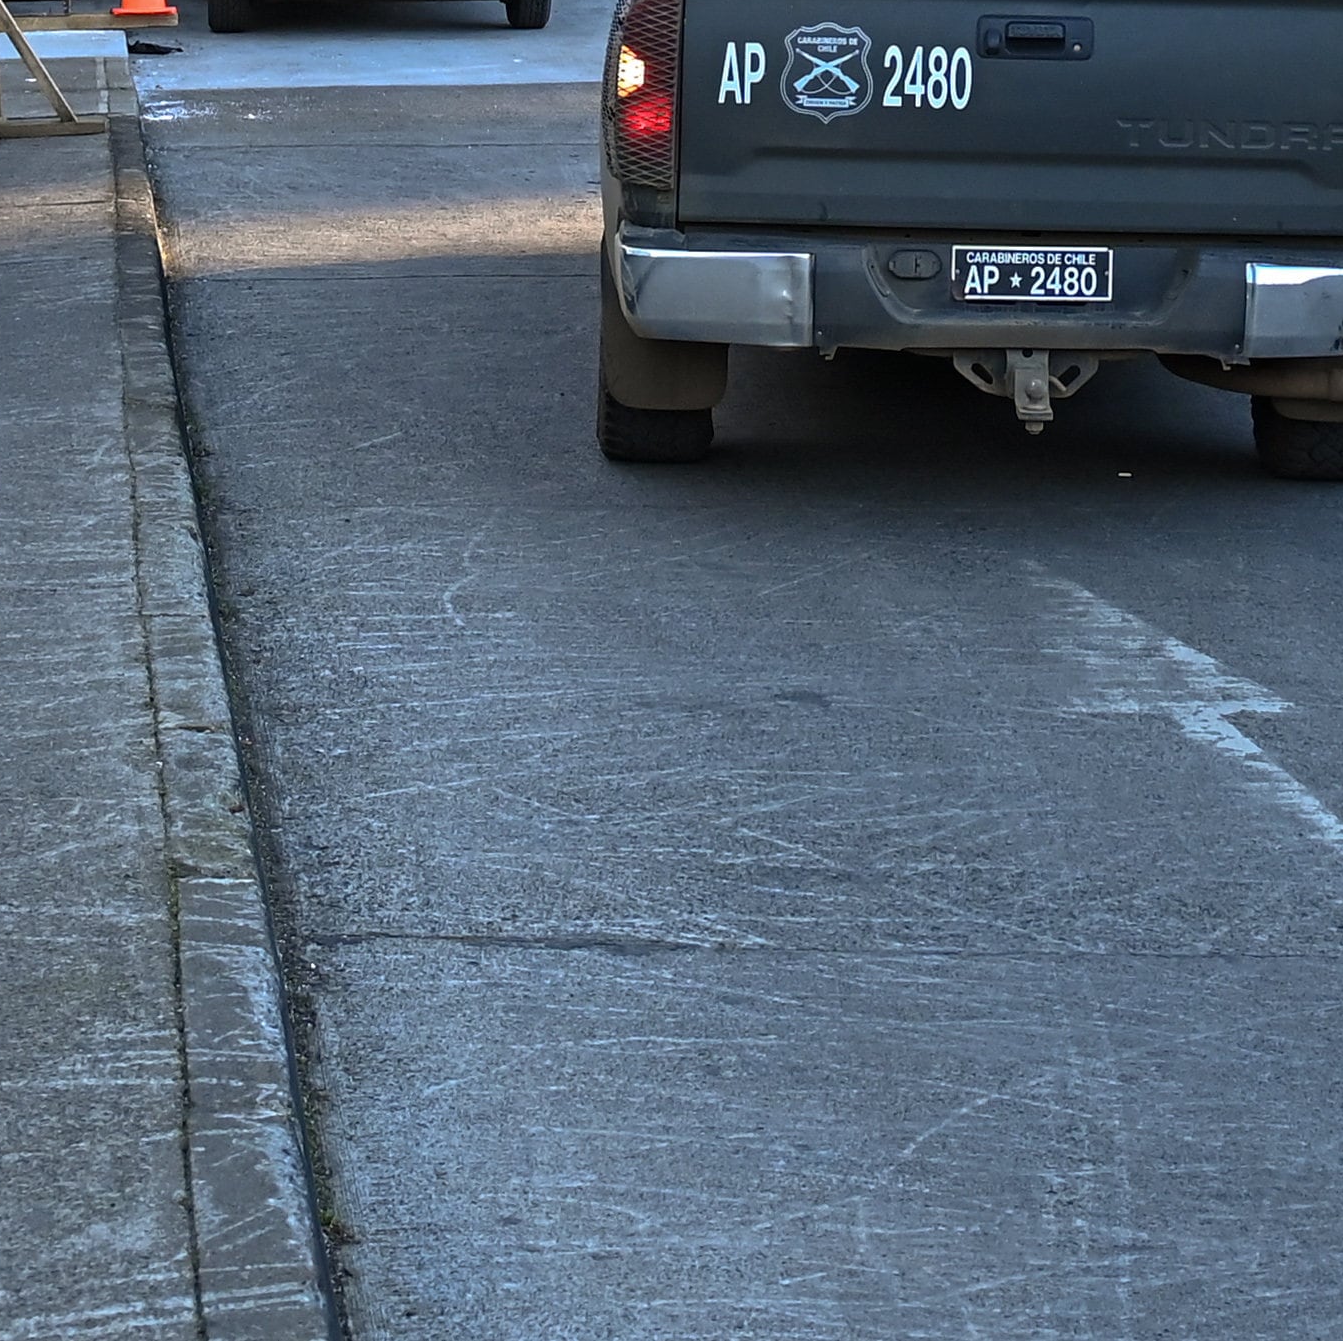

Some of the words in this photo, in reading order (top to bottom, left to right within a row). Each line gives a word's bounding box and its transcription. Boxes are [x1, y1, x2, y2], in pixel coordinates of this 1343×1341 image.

[718, 42, 766, 103] AP
[883, 45, 973, 109] 2480
[964, 265, 1000, 294] AP
[1030, 266, 1097, 296] 2480
[966, 251, 1045, 265] CARABINEROS
[1047, 253, 1062, 265] DE
[1064, 253, 1096, 266] CHILE
